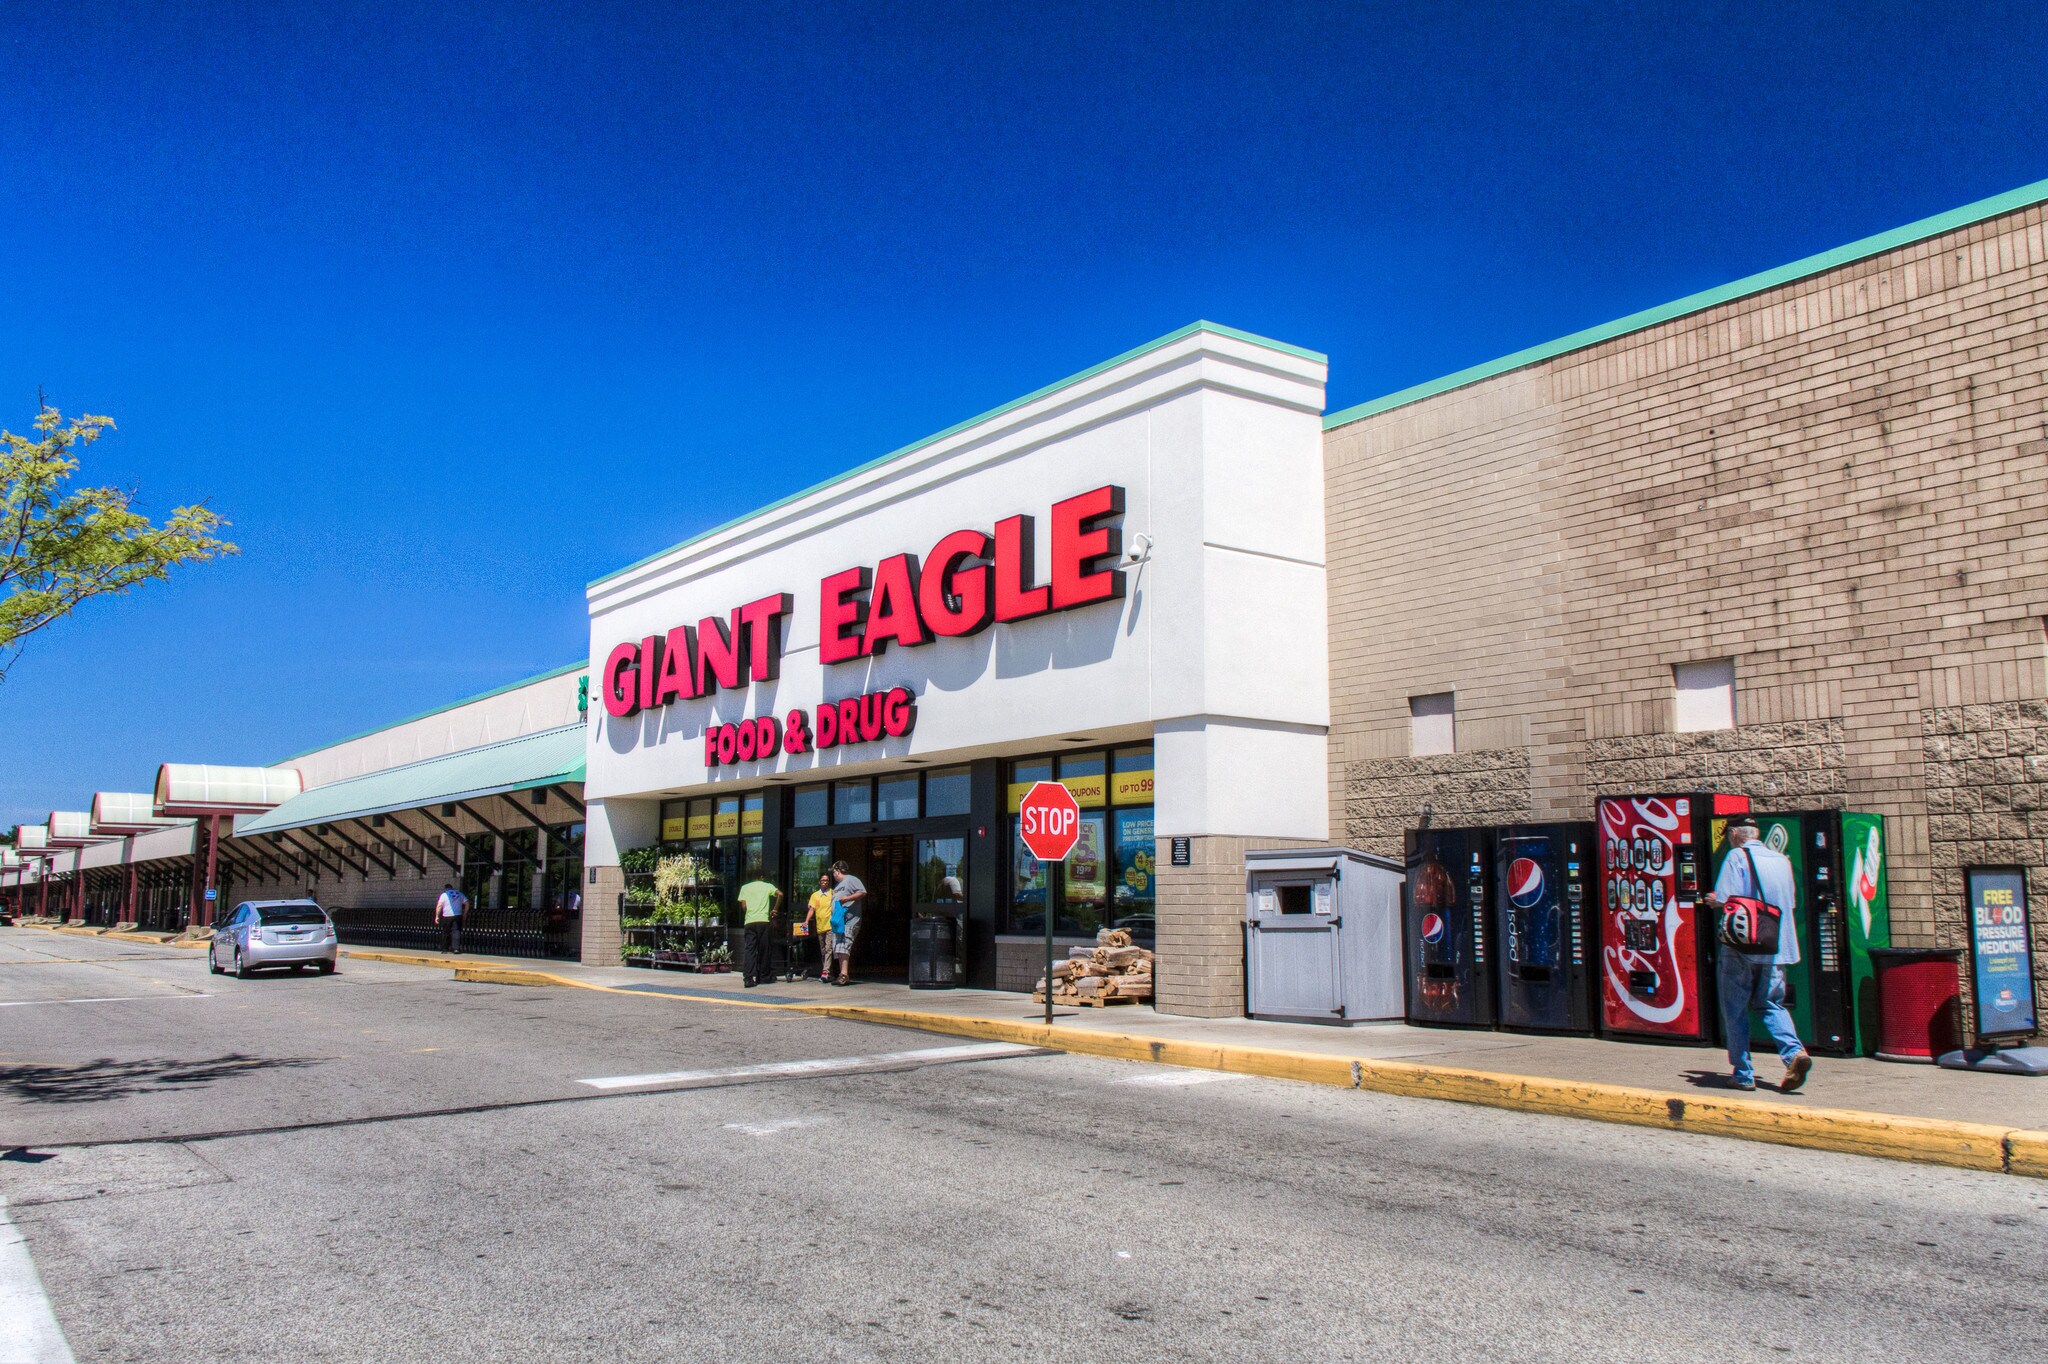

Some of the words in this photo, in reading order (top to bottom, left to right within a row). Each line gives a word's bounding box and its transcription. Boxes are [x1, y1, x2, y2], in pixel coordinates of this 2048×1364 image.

[603, 592, 793, 717] GIANT
[820, 485, 1126, 664] EAGLE
[705, 716, 782, 767] FOOD
[784, 709, 813, 754] &
[816, 687, 917, 748] DRUG
[1119, 784, 1129, 793] UP
[1130, 783, 1140, 792] TO
[1024, 806, 1075, 836] STOP
[1122, 820, 1136, 828] LOW
[1079, 824, 1093, 834] ICK
[1983, 890, 2013, 905] FREE
[1506, 909, 1519, 962] pepsi
[1976, 926, 2025, 939] PRESSURE
[1977, 940, 2026, 954] MEDICINE
